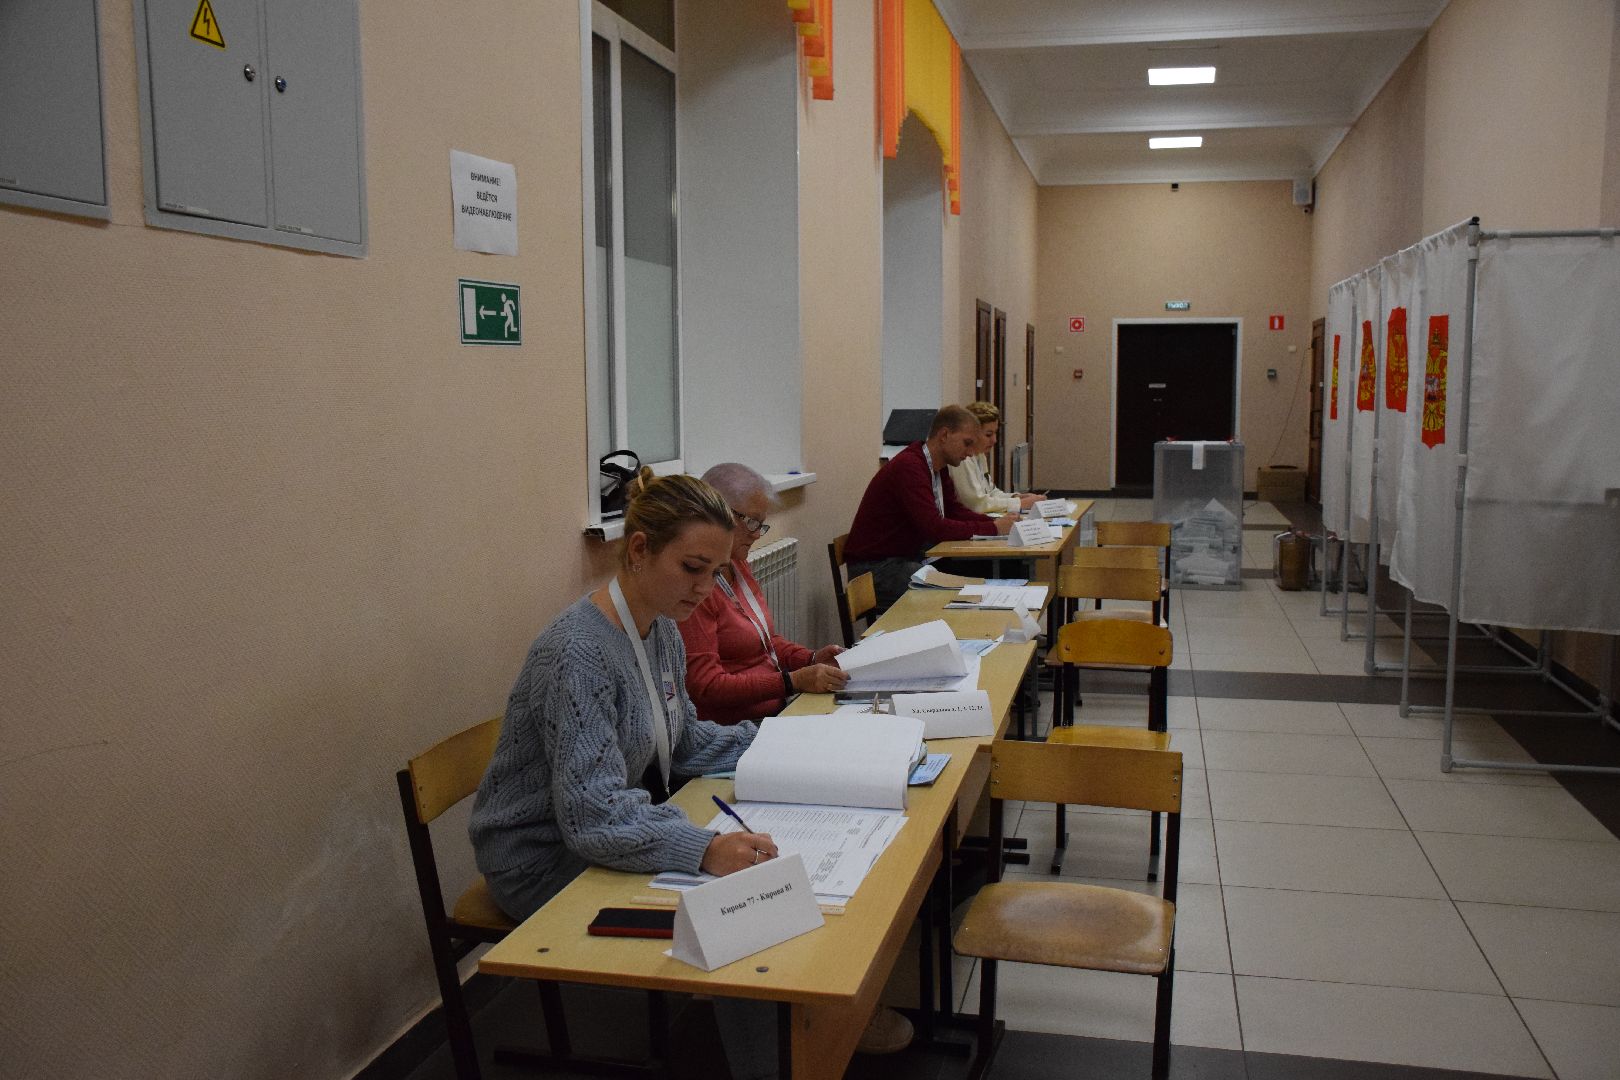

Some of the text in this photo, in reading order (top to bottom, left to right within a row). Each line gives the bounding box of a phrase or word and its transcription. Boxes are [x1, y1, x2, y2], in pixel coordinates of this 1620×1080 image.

[476, 191, 498, 203] ВЕДЁТСЯ
[461, 204, 512, 222] ВИДЕОНАБЛЮДЕНИЕ
[720, 901, 747, 916] Кирова
[746, 896, 755, 905] 77
[759, 887, 784, 901] Кирова
[784, 883, 793, 892] 81
